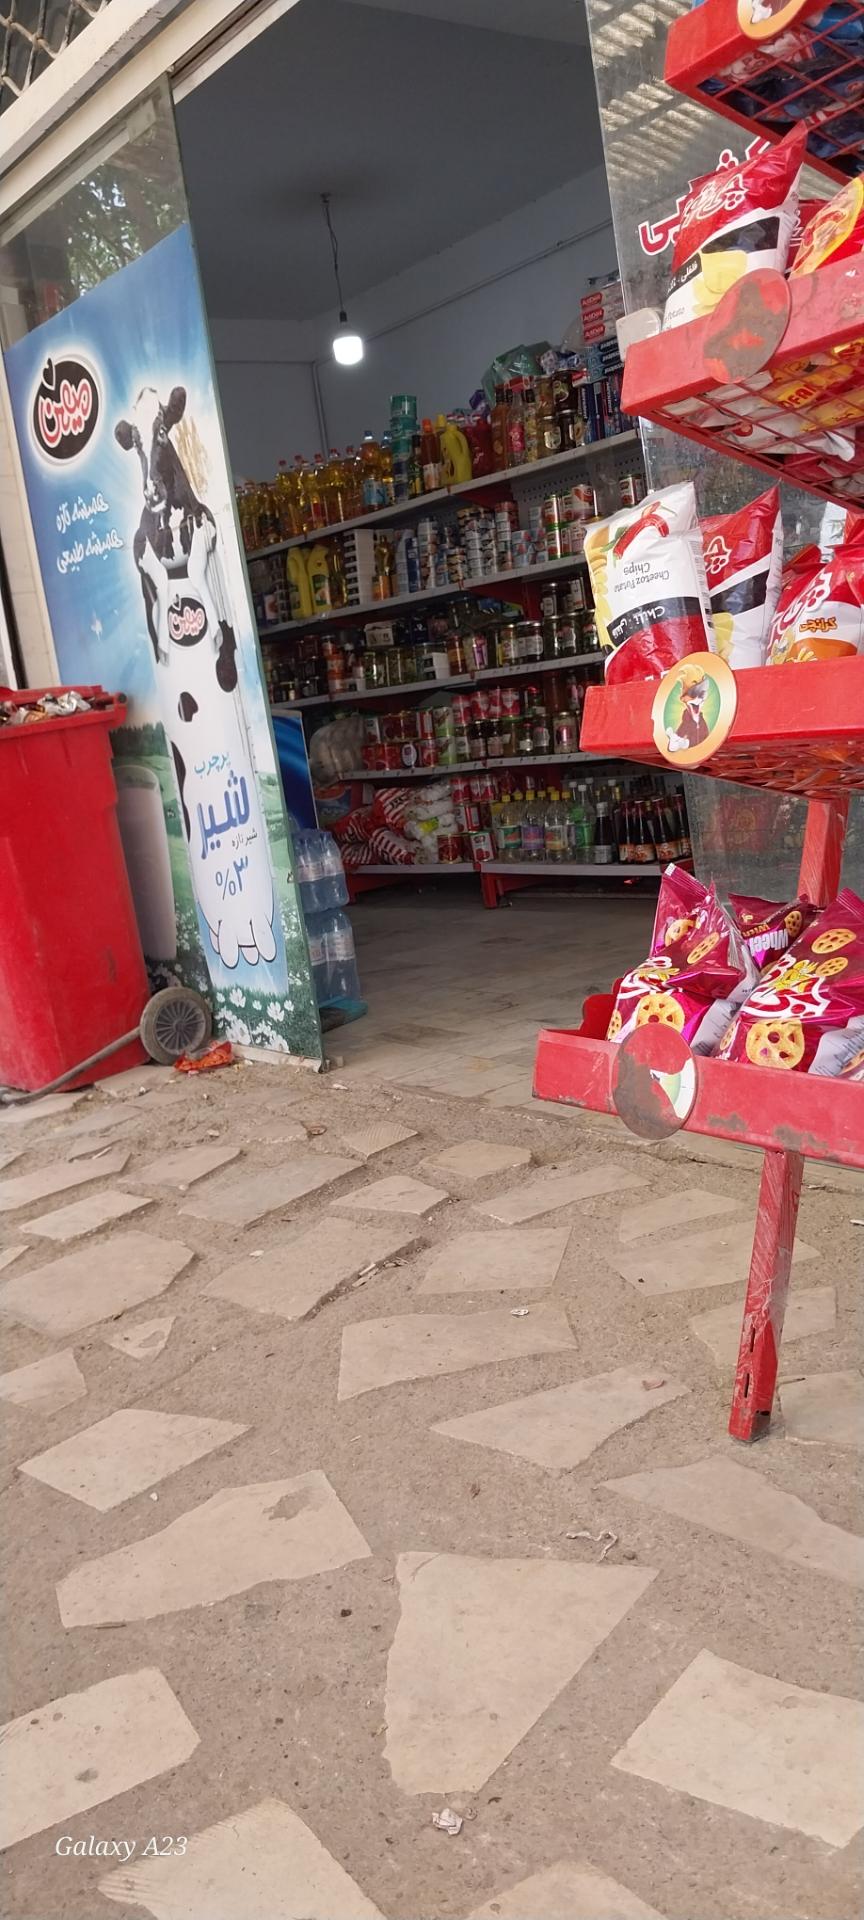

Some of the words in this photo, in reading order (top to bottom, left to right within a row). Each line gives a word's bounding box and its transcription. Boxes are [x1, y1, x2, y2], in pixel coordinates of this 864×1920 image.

[38, 378, 93, 449] میهن
[56, 502, 71, 534] تازه
[72, 492, 110, 525] همیشه
[57, 541, 84, 574] طبیعی
[86, 528, 124, 560] همیشه
[623, 562, 651, 576] Chips
[636, 570, 670, 585] Cheetoz
[168, 606, 206, 641] میهن
[197, 769, 251, 861] شیر
